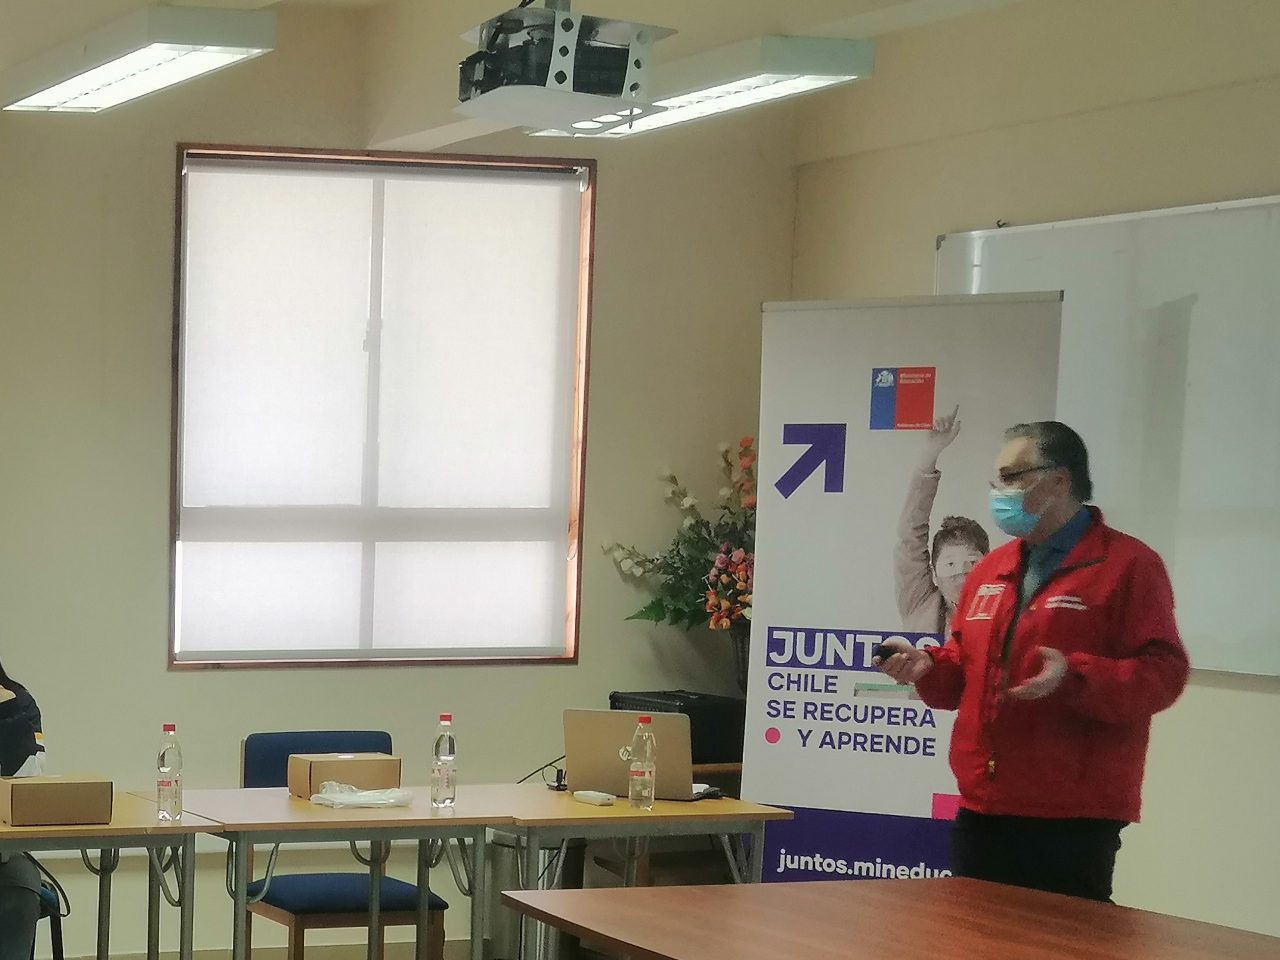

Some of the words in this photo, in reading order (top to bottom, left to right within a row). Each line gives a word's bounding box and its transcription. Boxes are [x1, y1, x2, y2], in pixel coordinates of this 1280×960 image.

[767, 672, 838, 694] CHILE
[766, 699, 796, 719] SE
[803, 701, 936, 728] RECUPERA
[797, 728, 814, 748] Y
[818, 730, 937, 757] APRENDE
